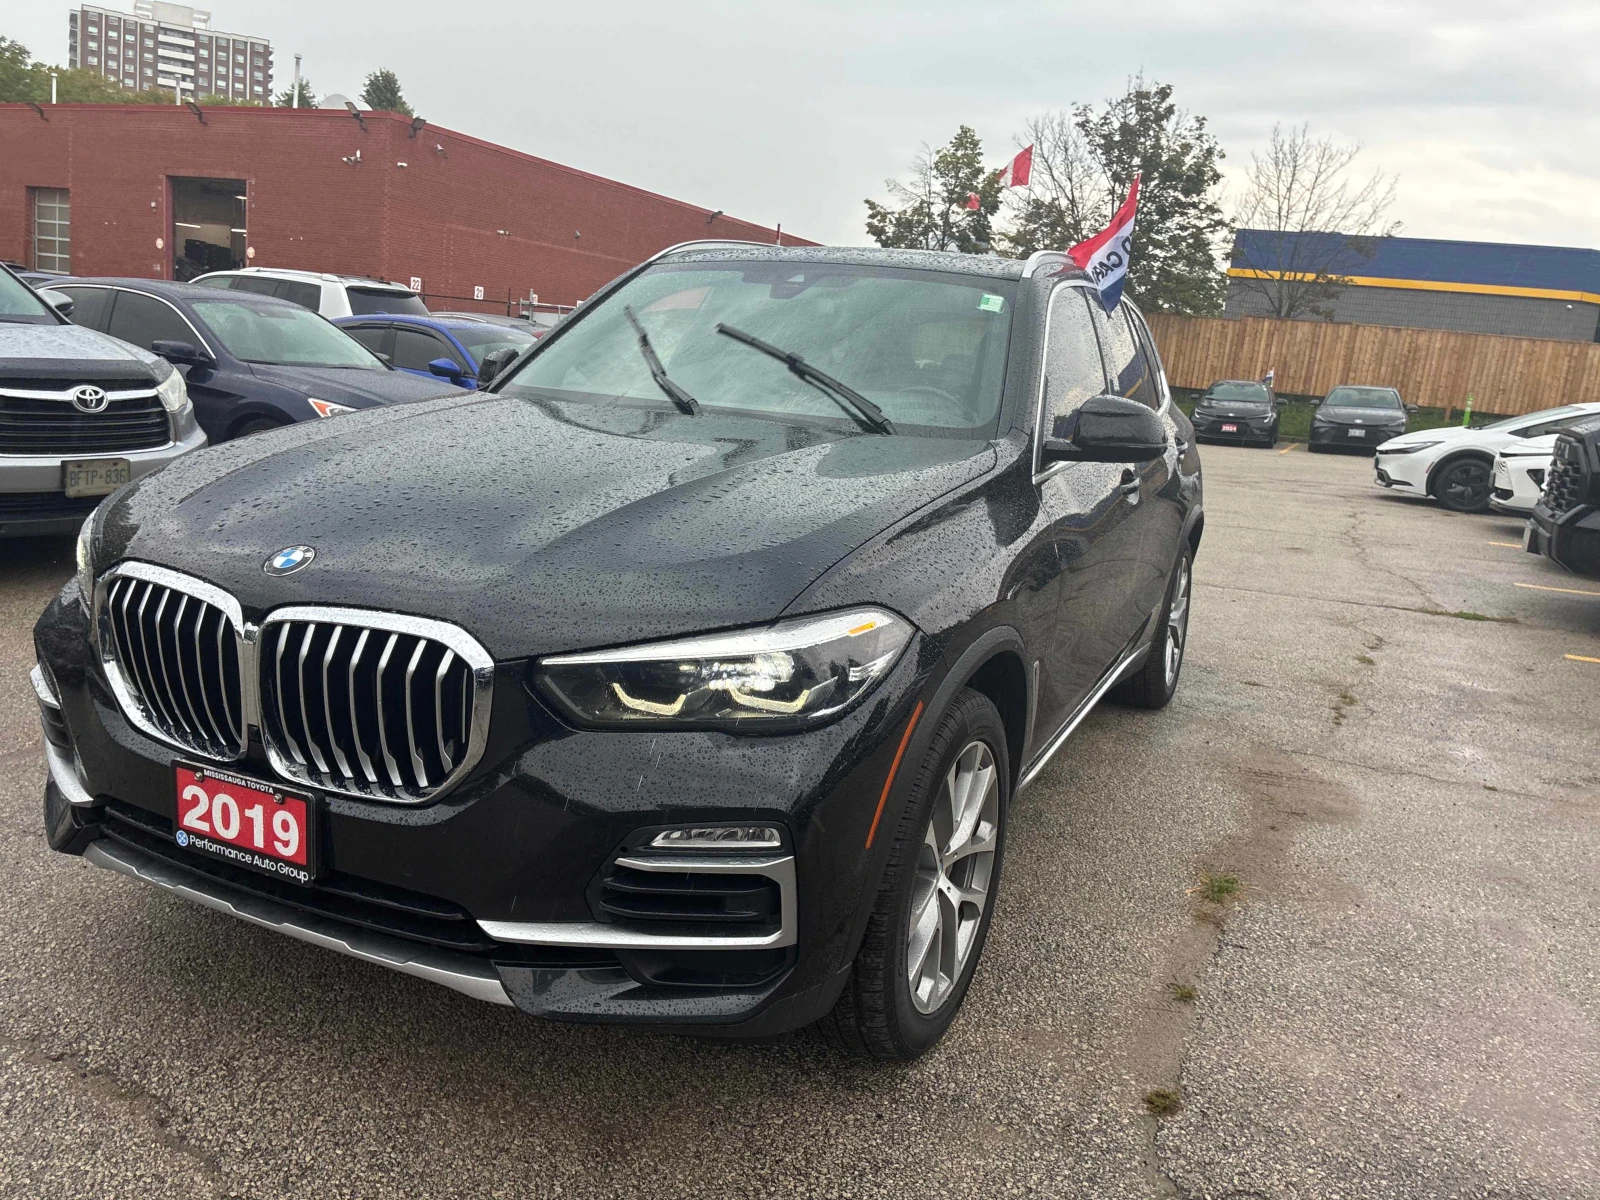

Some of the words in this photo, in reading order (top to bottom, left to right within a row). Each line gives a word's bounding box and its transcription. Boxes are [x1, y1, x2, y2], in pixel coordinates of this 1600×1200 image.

[412, 279, 420, 290] 22
[475, 287, 483, 298] 21
[105, 468, 127, 485] 836
[203, 769, 247, 787] MISSISSAUGA
[247, 781, 274, 794] TOYOTA
[182, 784, 300, 857] 2019
[189, 835, 252, 864] Performance
[253, 855, 276, 871] Auto
[277, 863, 309, 883] Group
